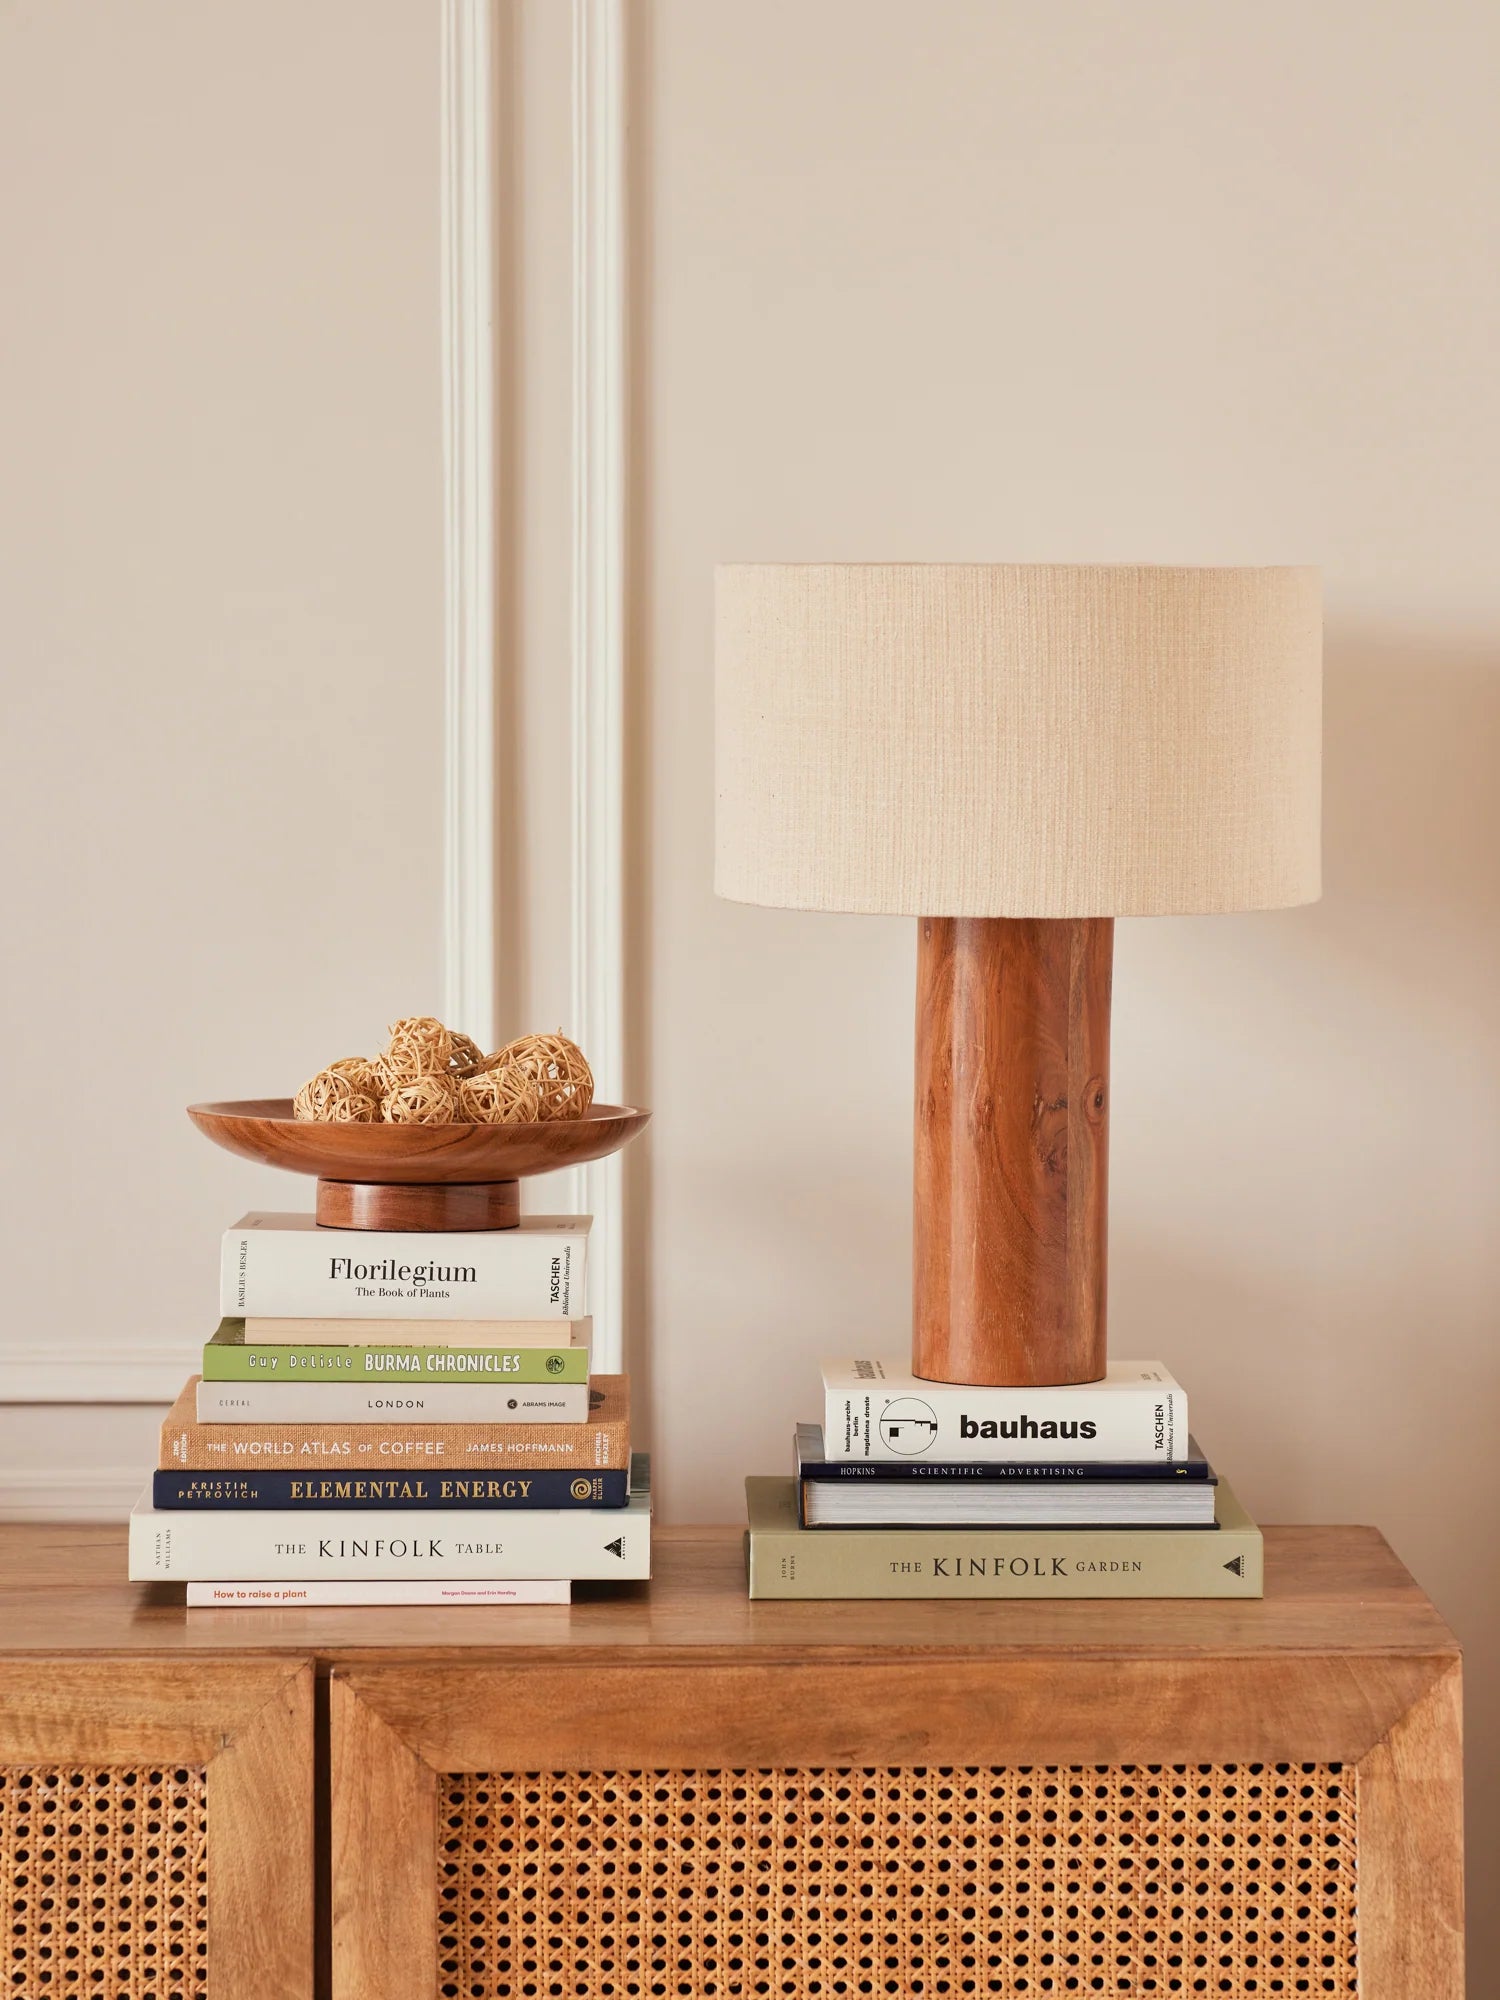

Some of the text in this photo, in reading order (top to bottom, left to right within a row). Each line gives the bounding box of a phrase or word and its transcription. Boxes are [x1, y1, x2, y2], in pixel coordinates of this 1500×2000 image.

[238, 1240, 248, 1307] BASILIUS BESLER
[328, 1257, 478, 1287] Florilegium
[550, 1257, 561, 1303] TASCHEN
[355, 1287, 450, 1298] The Book of Plants
[562, 1281, 570, 1315] Bibliotheca
[249, 1354, 353, 1370] Guy Delisle
[364, 1353, 521, 1373] BURMA CHRONICLES
[219, 1399, 251, 1407] CEREAL
[367, 1400, 425, 1408] LONDON
[960, 1415, 1097, 1439] bauhaus
[1154, 1404, 1164, 1450] TASCHEN
[207, 1442, 445, 1455] THE WORLD ATLAS OF COFFEE
[466, 1443, 575, 1453] JAMES HOFFMANN
[840, 1467, 876, 1476] HOPKINS
[912, 1467, 1085, 1476] SCIENTIFIC ADVERTISING
[191, 1482, 248, 1490] KRISTIN
[290, 1481, 533, 1499] ELEMENTAL ENERGY
[178, 1490, 258, 1499] PETROVICH
[274, 1540, 504, 1557] THE KINFOLK TABLE
[890, 1558, 1143, 1577] THE KINFOLK GARDEN
[213, 1590, 235, 1599] How
[236, 1590, 247, 1598] to
[248, 1590, 272, 1598] raise
[282, 1590, 307, 1600] plant
